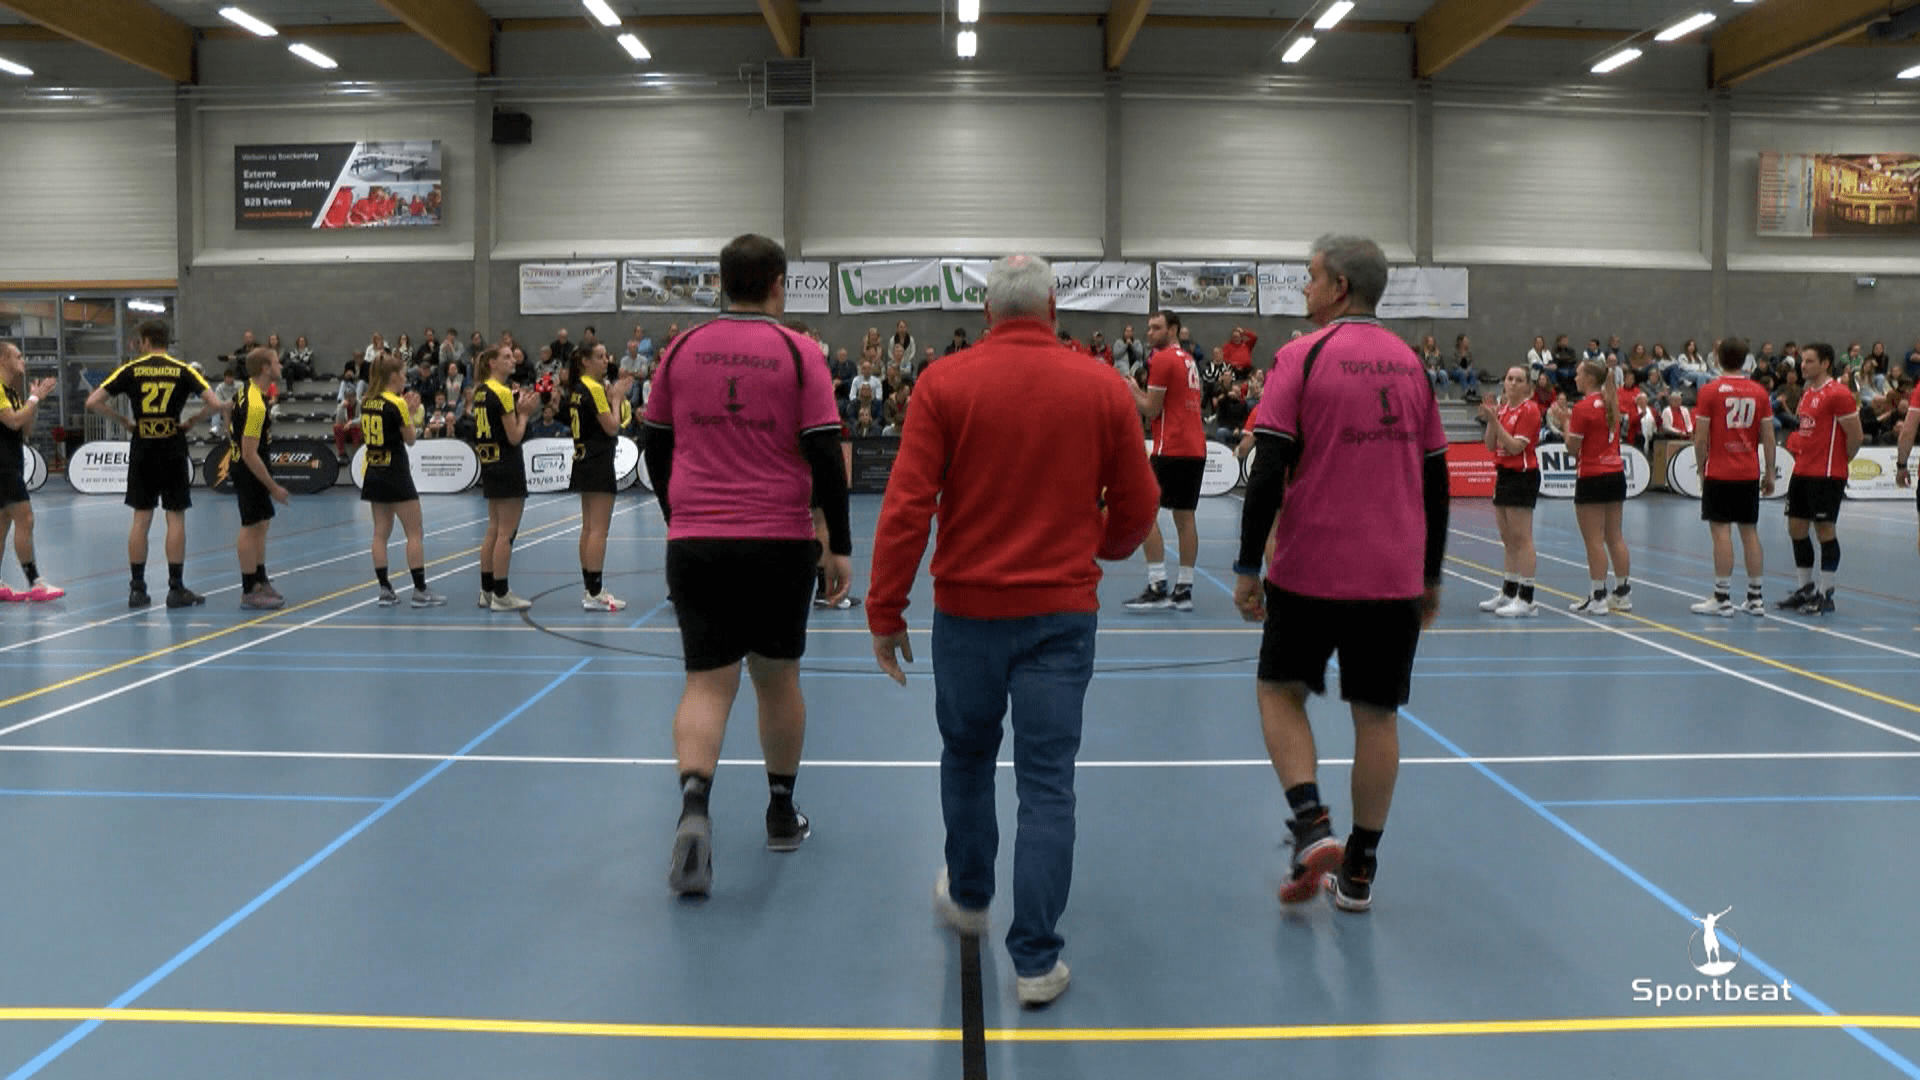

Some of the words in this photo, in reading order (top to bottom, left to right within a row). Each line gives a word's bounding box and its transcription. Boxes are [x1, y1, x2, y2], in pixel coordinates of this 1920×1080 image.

[243, 170, 277, 178] Externe
[243, 179, 331, 191] Bedrijfsvergadering
[244, 198, 261, 206] B2B
[263, 197, 292, 206] Events
[786, 275, 829, 290] TFOX
[941, 265, 987, 303] Ver
[1056, 275, 1150, 290] BRIGHTFOX
[1259, 273, 1297, 284] Blue
[841, 268, 940, 306] Vertom
[694, 352, 779, 373] TOPLEAGUE
[134, 366, 181, 378] SCHOUMACKER
[141, 381, 176, 413] 27
[690, 411, 776, 430] Sportbeat
[1725, 397, 1756, 429] 20
[362, 413, 385, 447] 99
[85, 452, 130, 465] THEEU
[1542, 451, 1578, 471] ND
[527, 474, 571, 486] 475/69.10.5
